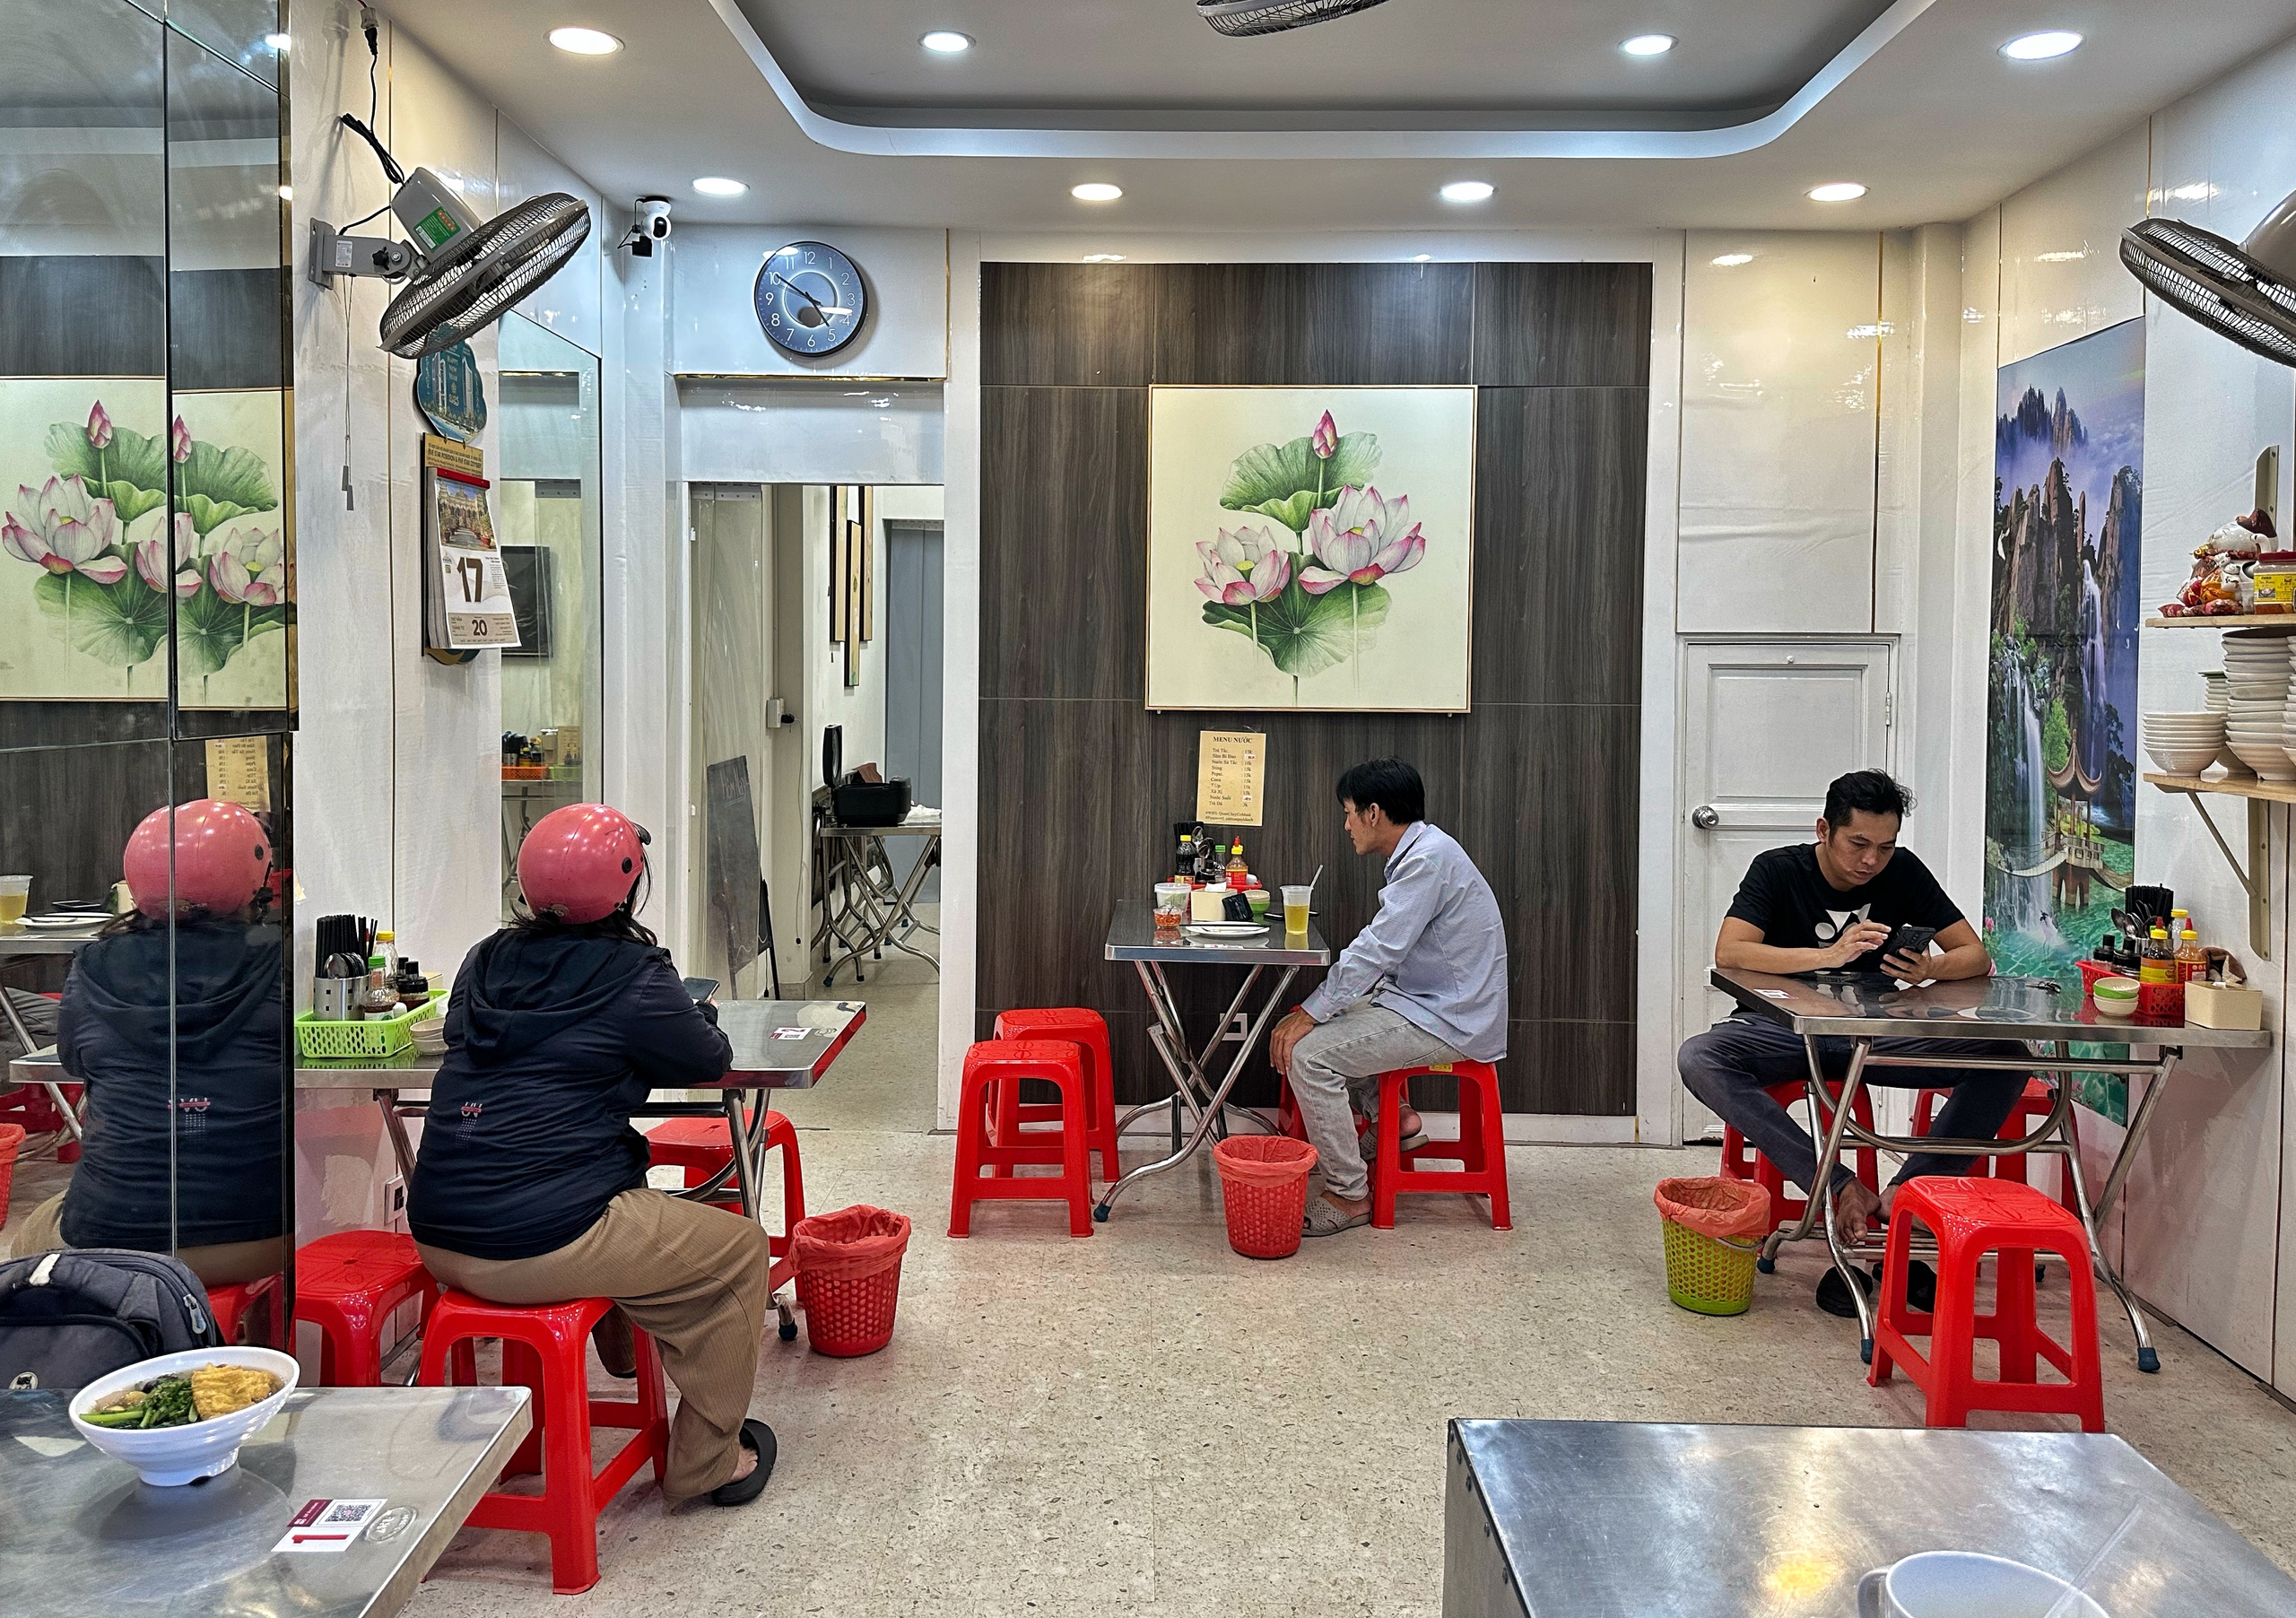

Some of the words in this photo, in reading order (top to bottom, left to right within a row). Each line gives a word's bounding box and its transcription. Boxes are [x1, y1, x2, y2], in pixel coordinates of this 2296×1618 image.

[786, 257, 795, 269] 11
[804, 251, 816, 265] 12
[829, 257, 832, 270] 1
[769, 272, 781, 285] 10
[841, 273, 849, 285] 2
[765, 292, 774, 306] 9
[848, 293, 856, 306] 3
[771, 313, 780, 326] 8
[839, 314, 850, 326] 4
[787, 329, 795, 341] 7
[807, 335, 815, 347] 6
[828, 329, 836, 341] 5
[457, 557, 483, 603] 17
[472, 620, 488, 636] 20
[291, 1534, 350, 1544] 1
